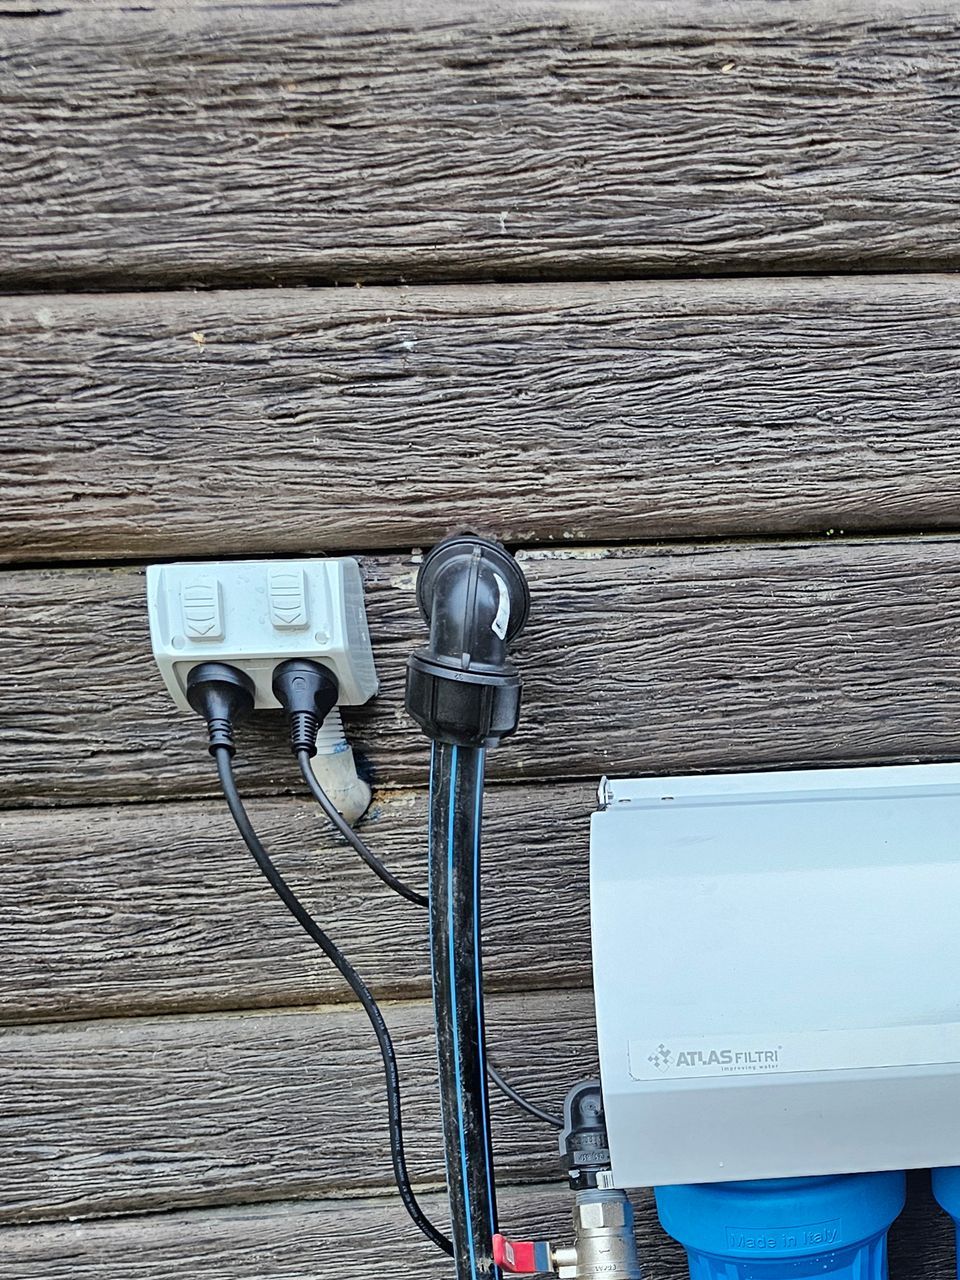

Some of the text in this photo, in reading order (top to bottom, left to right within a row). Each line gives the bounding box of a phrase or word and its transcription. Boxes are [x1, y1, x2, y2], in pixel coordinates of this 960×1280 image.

[676, 1049, 779, 1068] ATLAS FILTRI
[728, 1227, 838, 1249] Made in Italy
